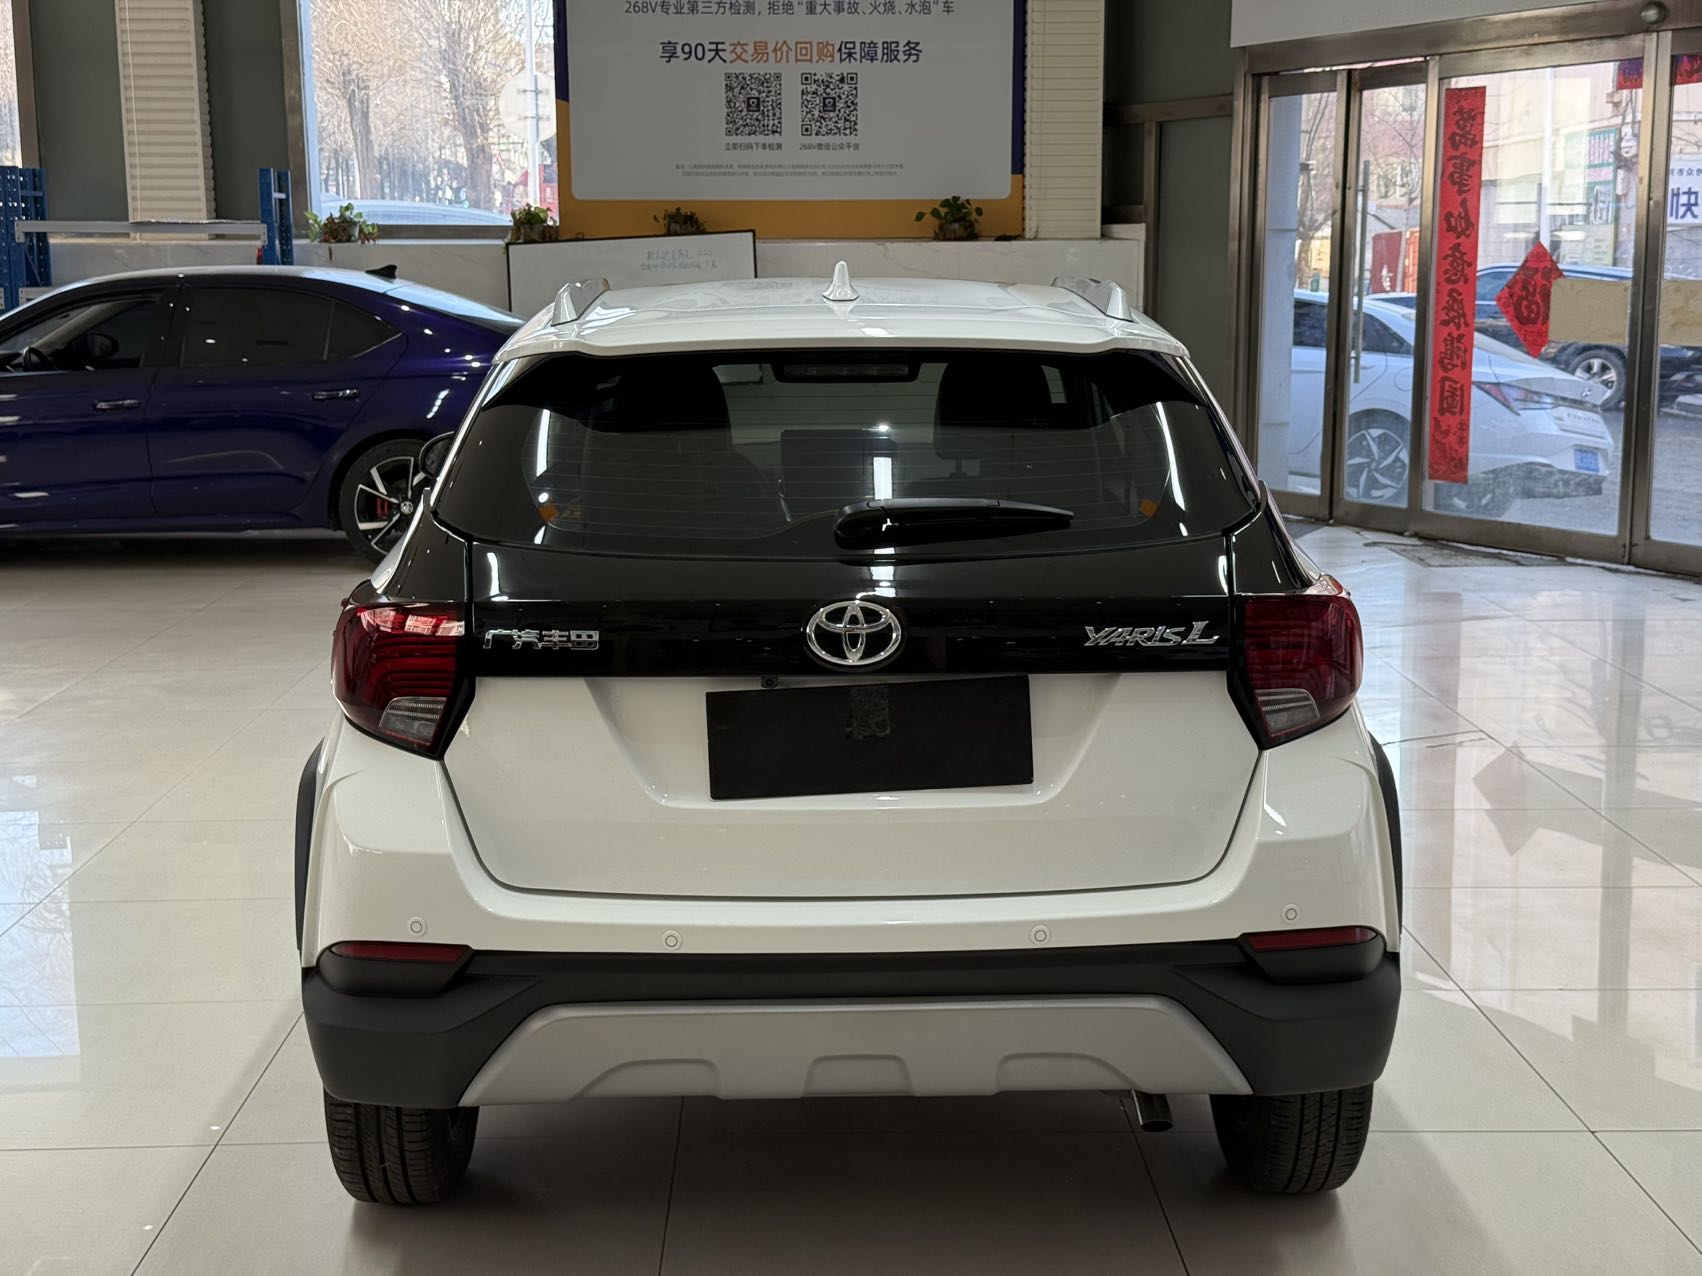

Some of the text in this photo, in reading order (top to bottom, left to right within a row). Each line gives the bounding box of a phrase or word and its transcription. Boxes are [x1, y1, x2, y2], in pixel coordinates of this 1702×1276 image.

[659, 40, 923, 64] 享90天交易价回购保障服务
[1669, 187, 1699, 220] 快
[482, 629, 600, 650] 广汽丰田
[1083, 620, 1220, 647] YARIS L
